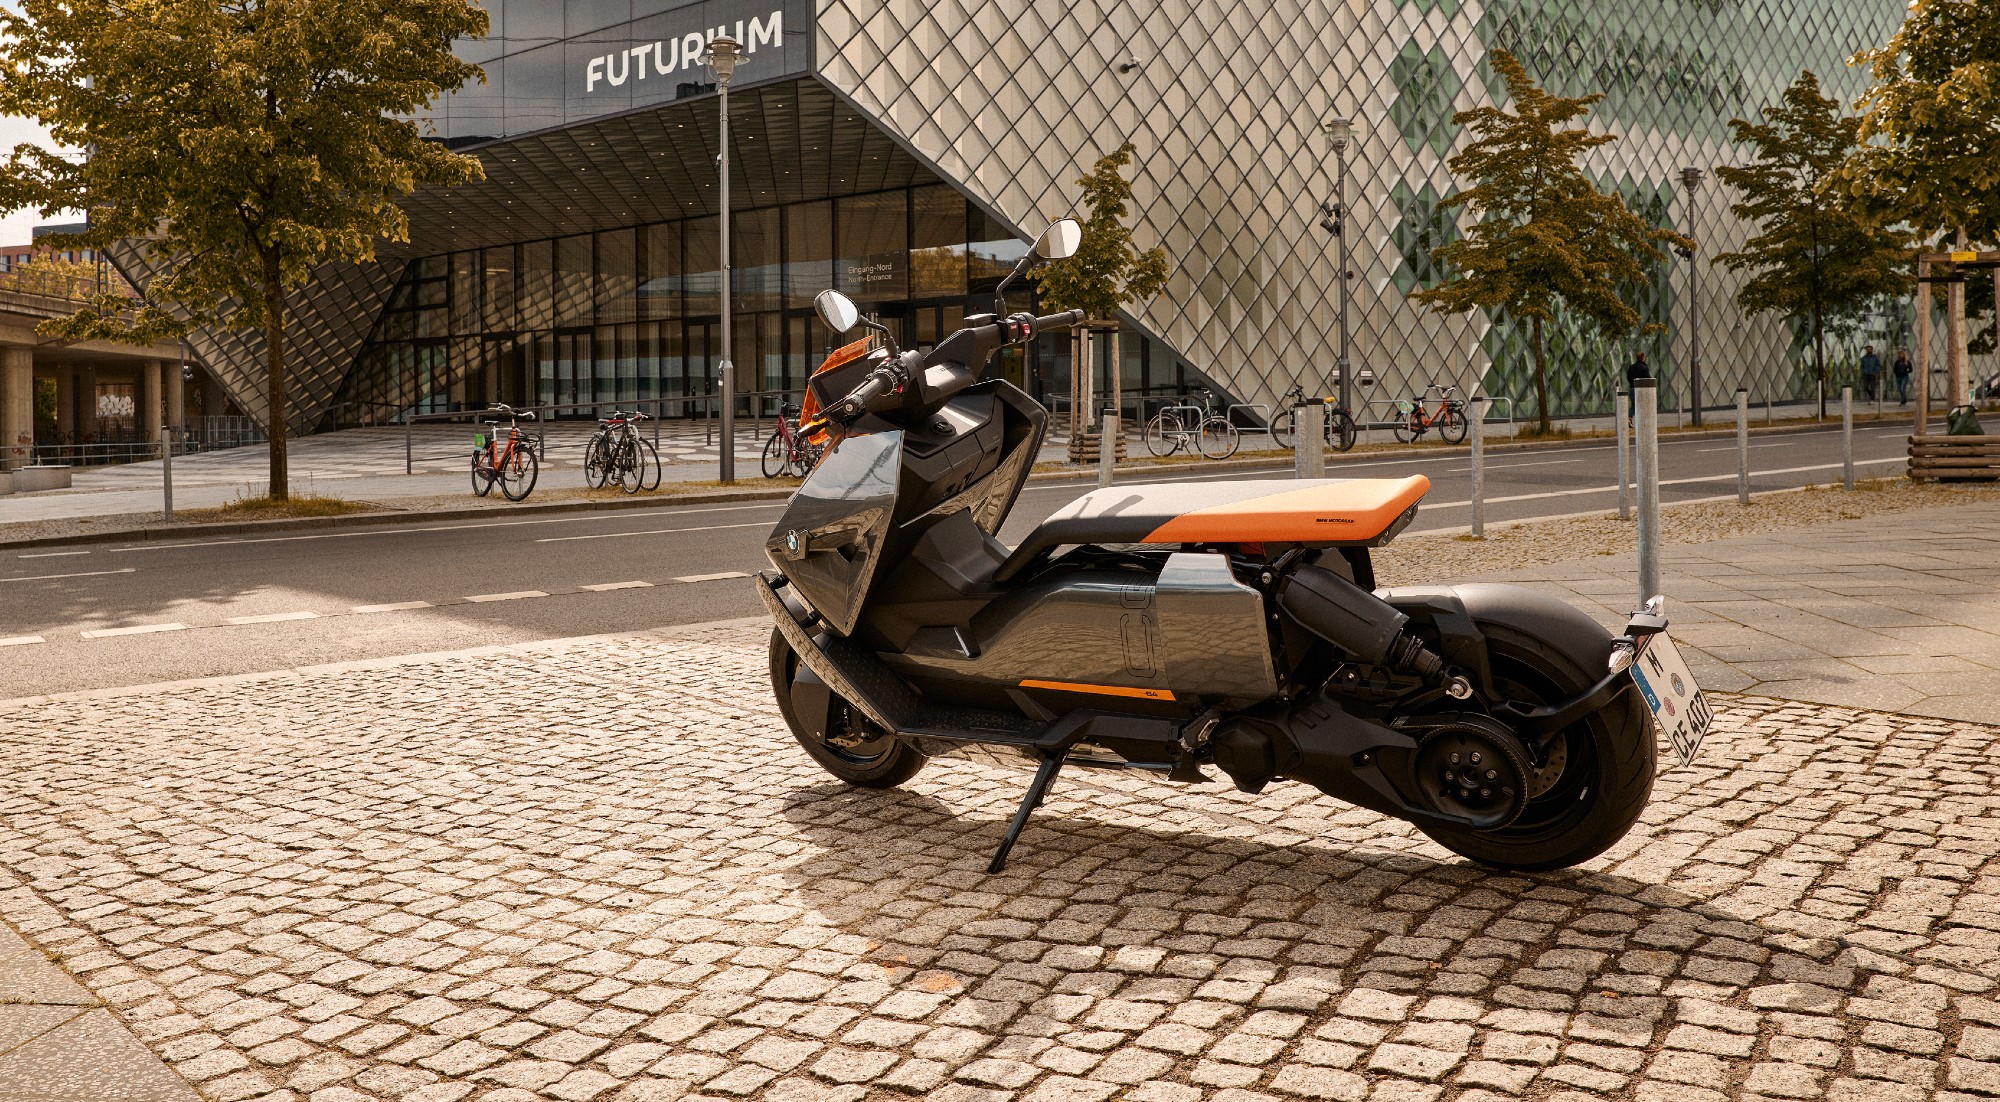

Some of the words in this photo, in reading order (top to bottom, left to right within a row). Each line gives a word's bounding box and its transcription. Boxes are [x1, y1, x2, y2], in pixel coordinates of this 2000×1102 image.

[848, 263, 892, 274] Eingang-Nord
[1645, 647, 1664, 678] M
[1648, 693, 1656, 706] D
[1672, 720, 1696, 759] CE
[1686, 690, 1710, 735] 407
